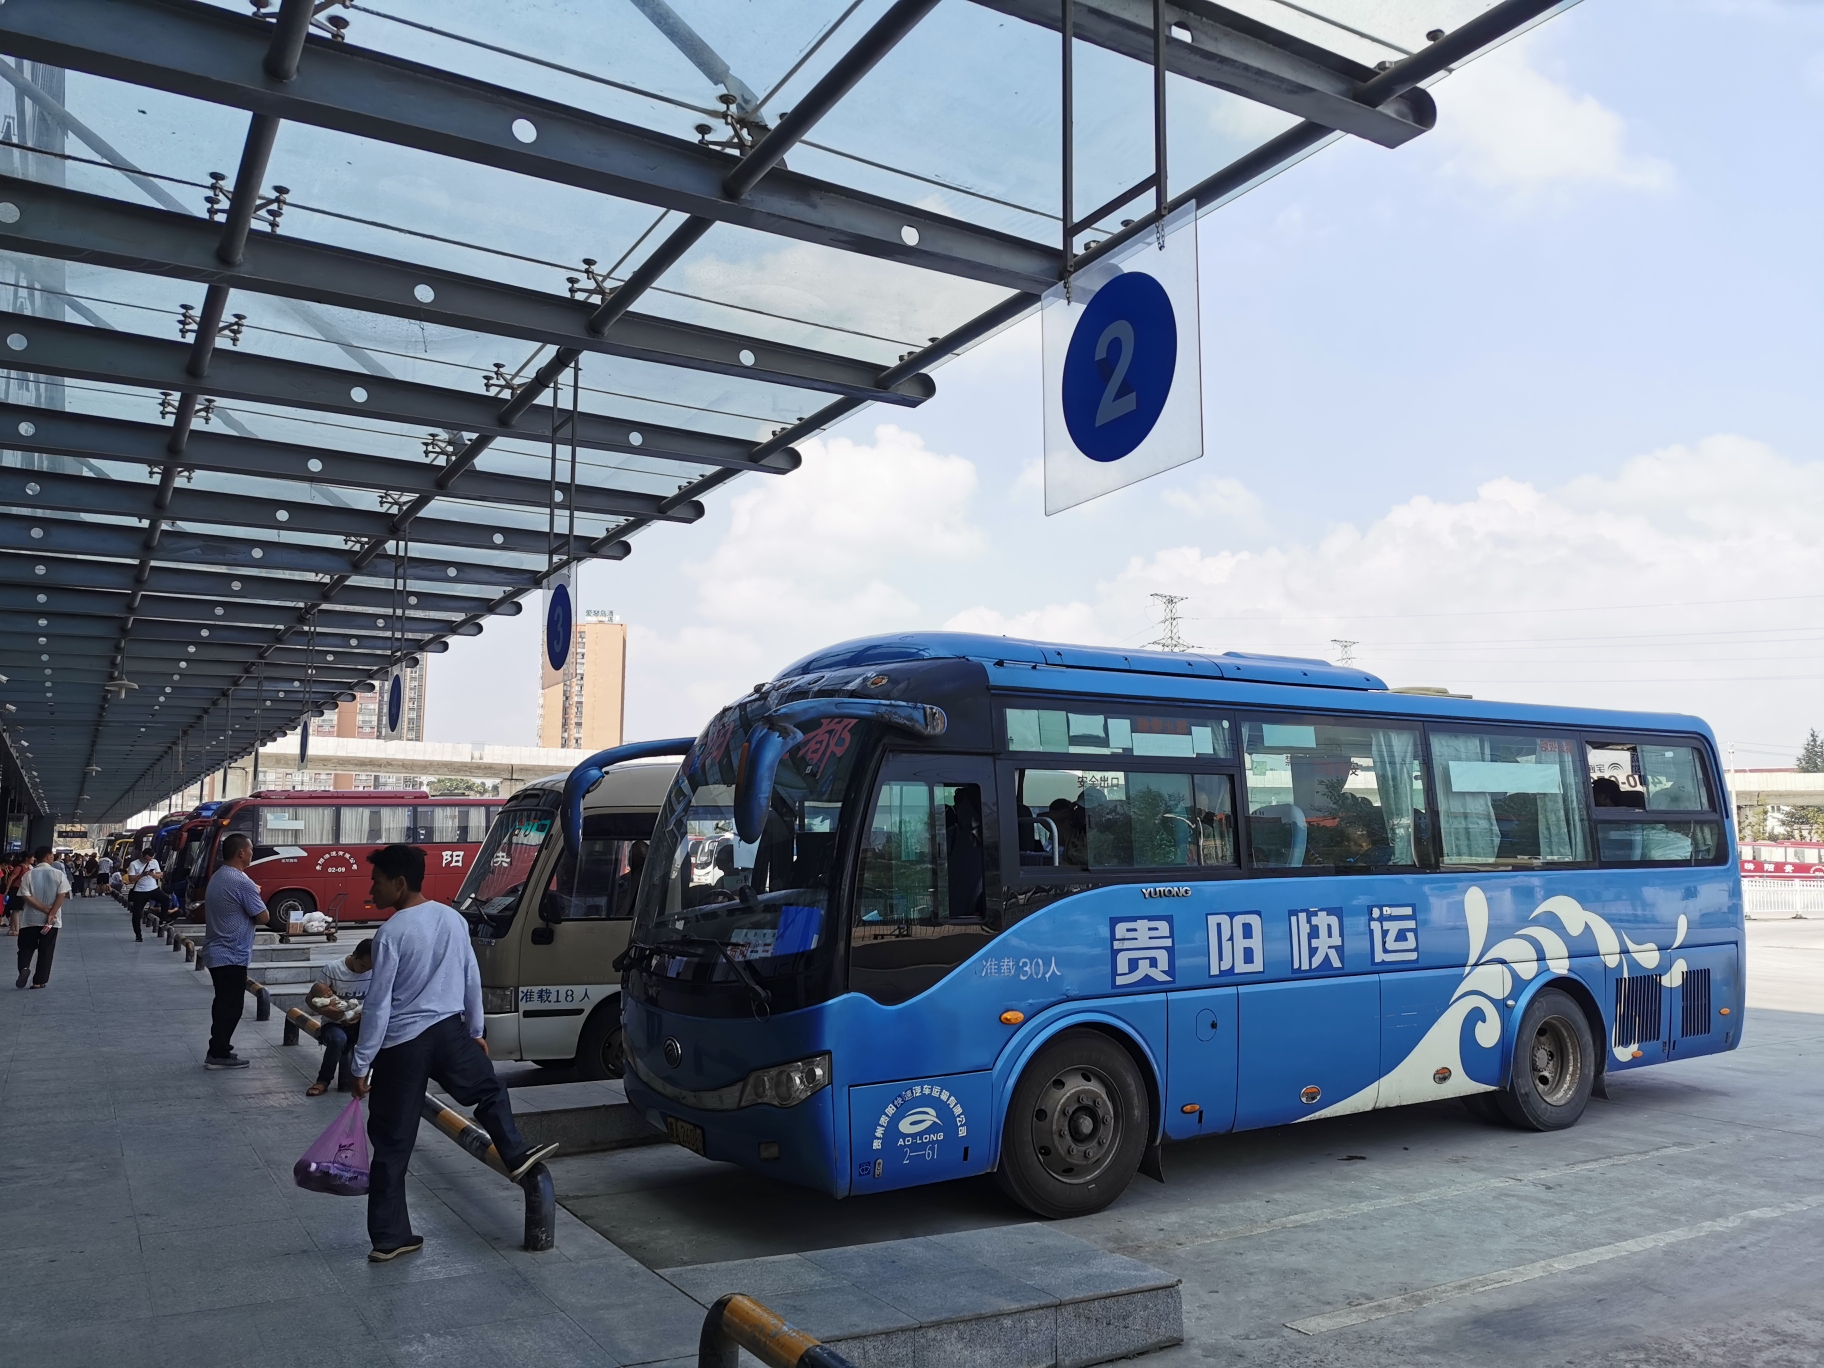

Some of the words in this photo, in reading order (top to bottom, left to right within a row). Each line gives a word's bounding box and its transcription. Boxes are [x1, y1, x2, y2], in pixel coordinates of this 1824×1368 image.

[1095, 319, 1137, 428] 2
[553, 605, 564, 653] 3
[783, 718, 860, 780] 都
[1077, 774, 1120, 789] 安全出口
[1141, 886, 1192, 899] YUTONG
[1112, 905, 1419, 987] 贵阳快运
[981, 955, 1062, 983] 准载30人
[519, 987, 592, 1004] 准载18人
[897, 1132, 944, 1147] AO-LONG
